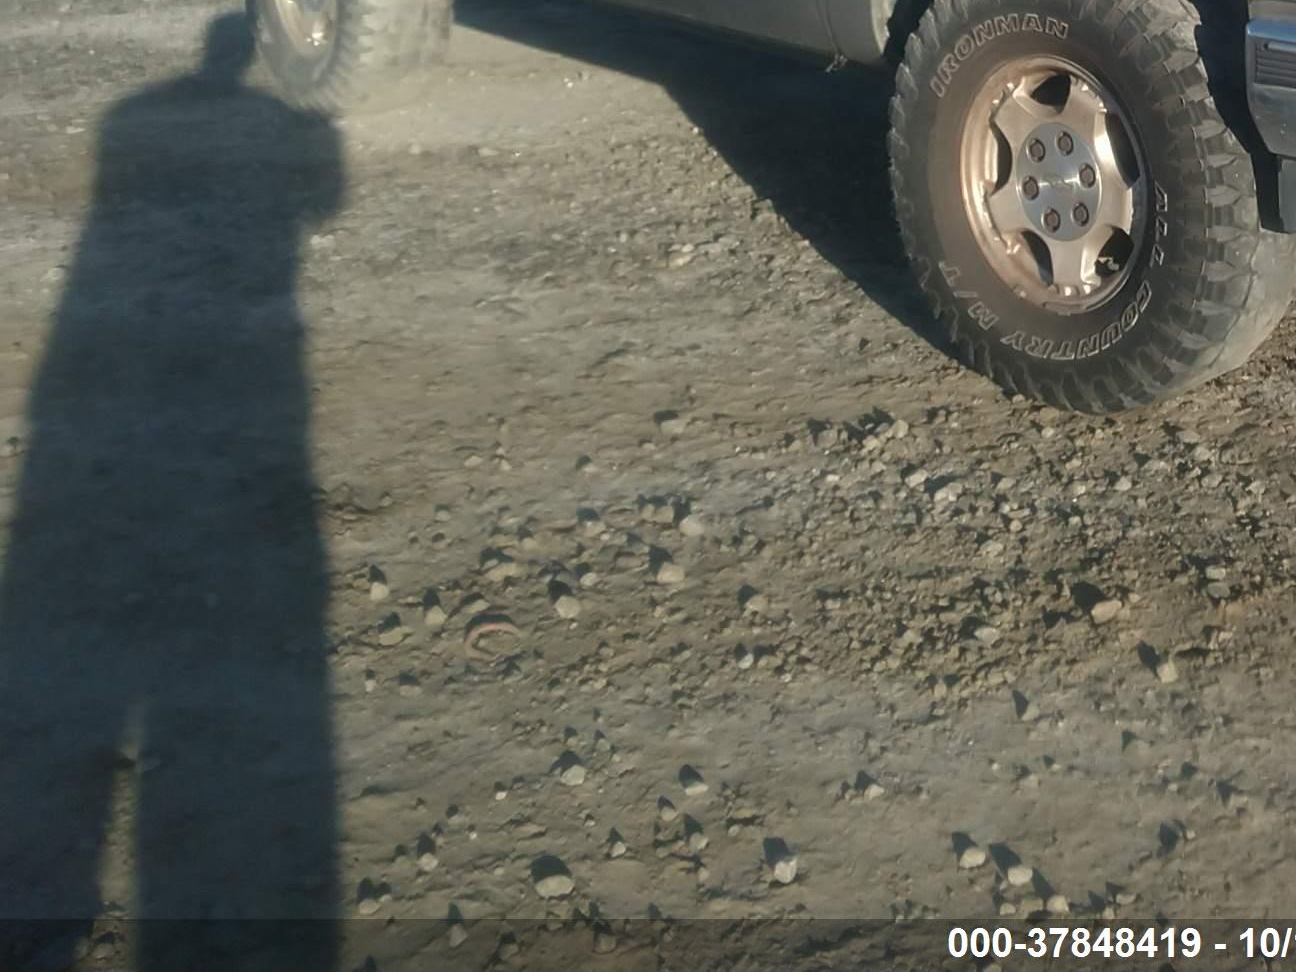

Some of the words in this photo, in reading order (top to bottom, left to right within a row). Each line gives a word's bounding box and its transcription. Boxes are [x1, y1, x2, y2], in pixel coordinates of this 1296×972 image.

[930, 13, 1069, 98] IRONMAN
[1151, 180, 1168, 268] ALL
[938, 261, 999, 331] M/T
[1000, 279, 1153, 360] COUNTRY
